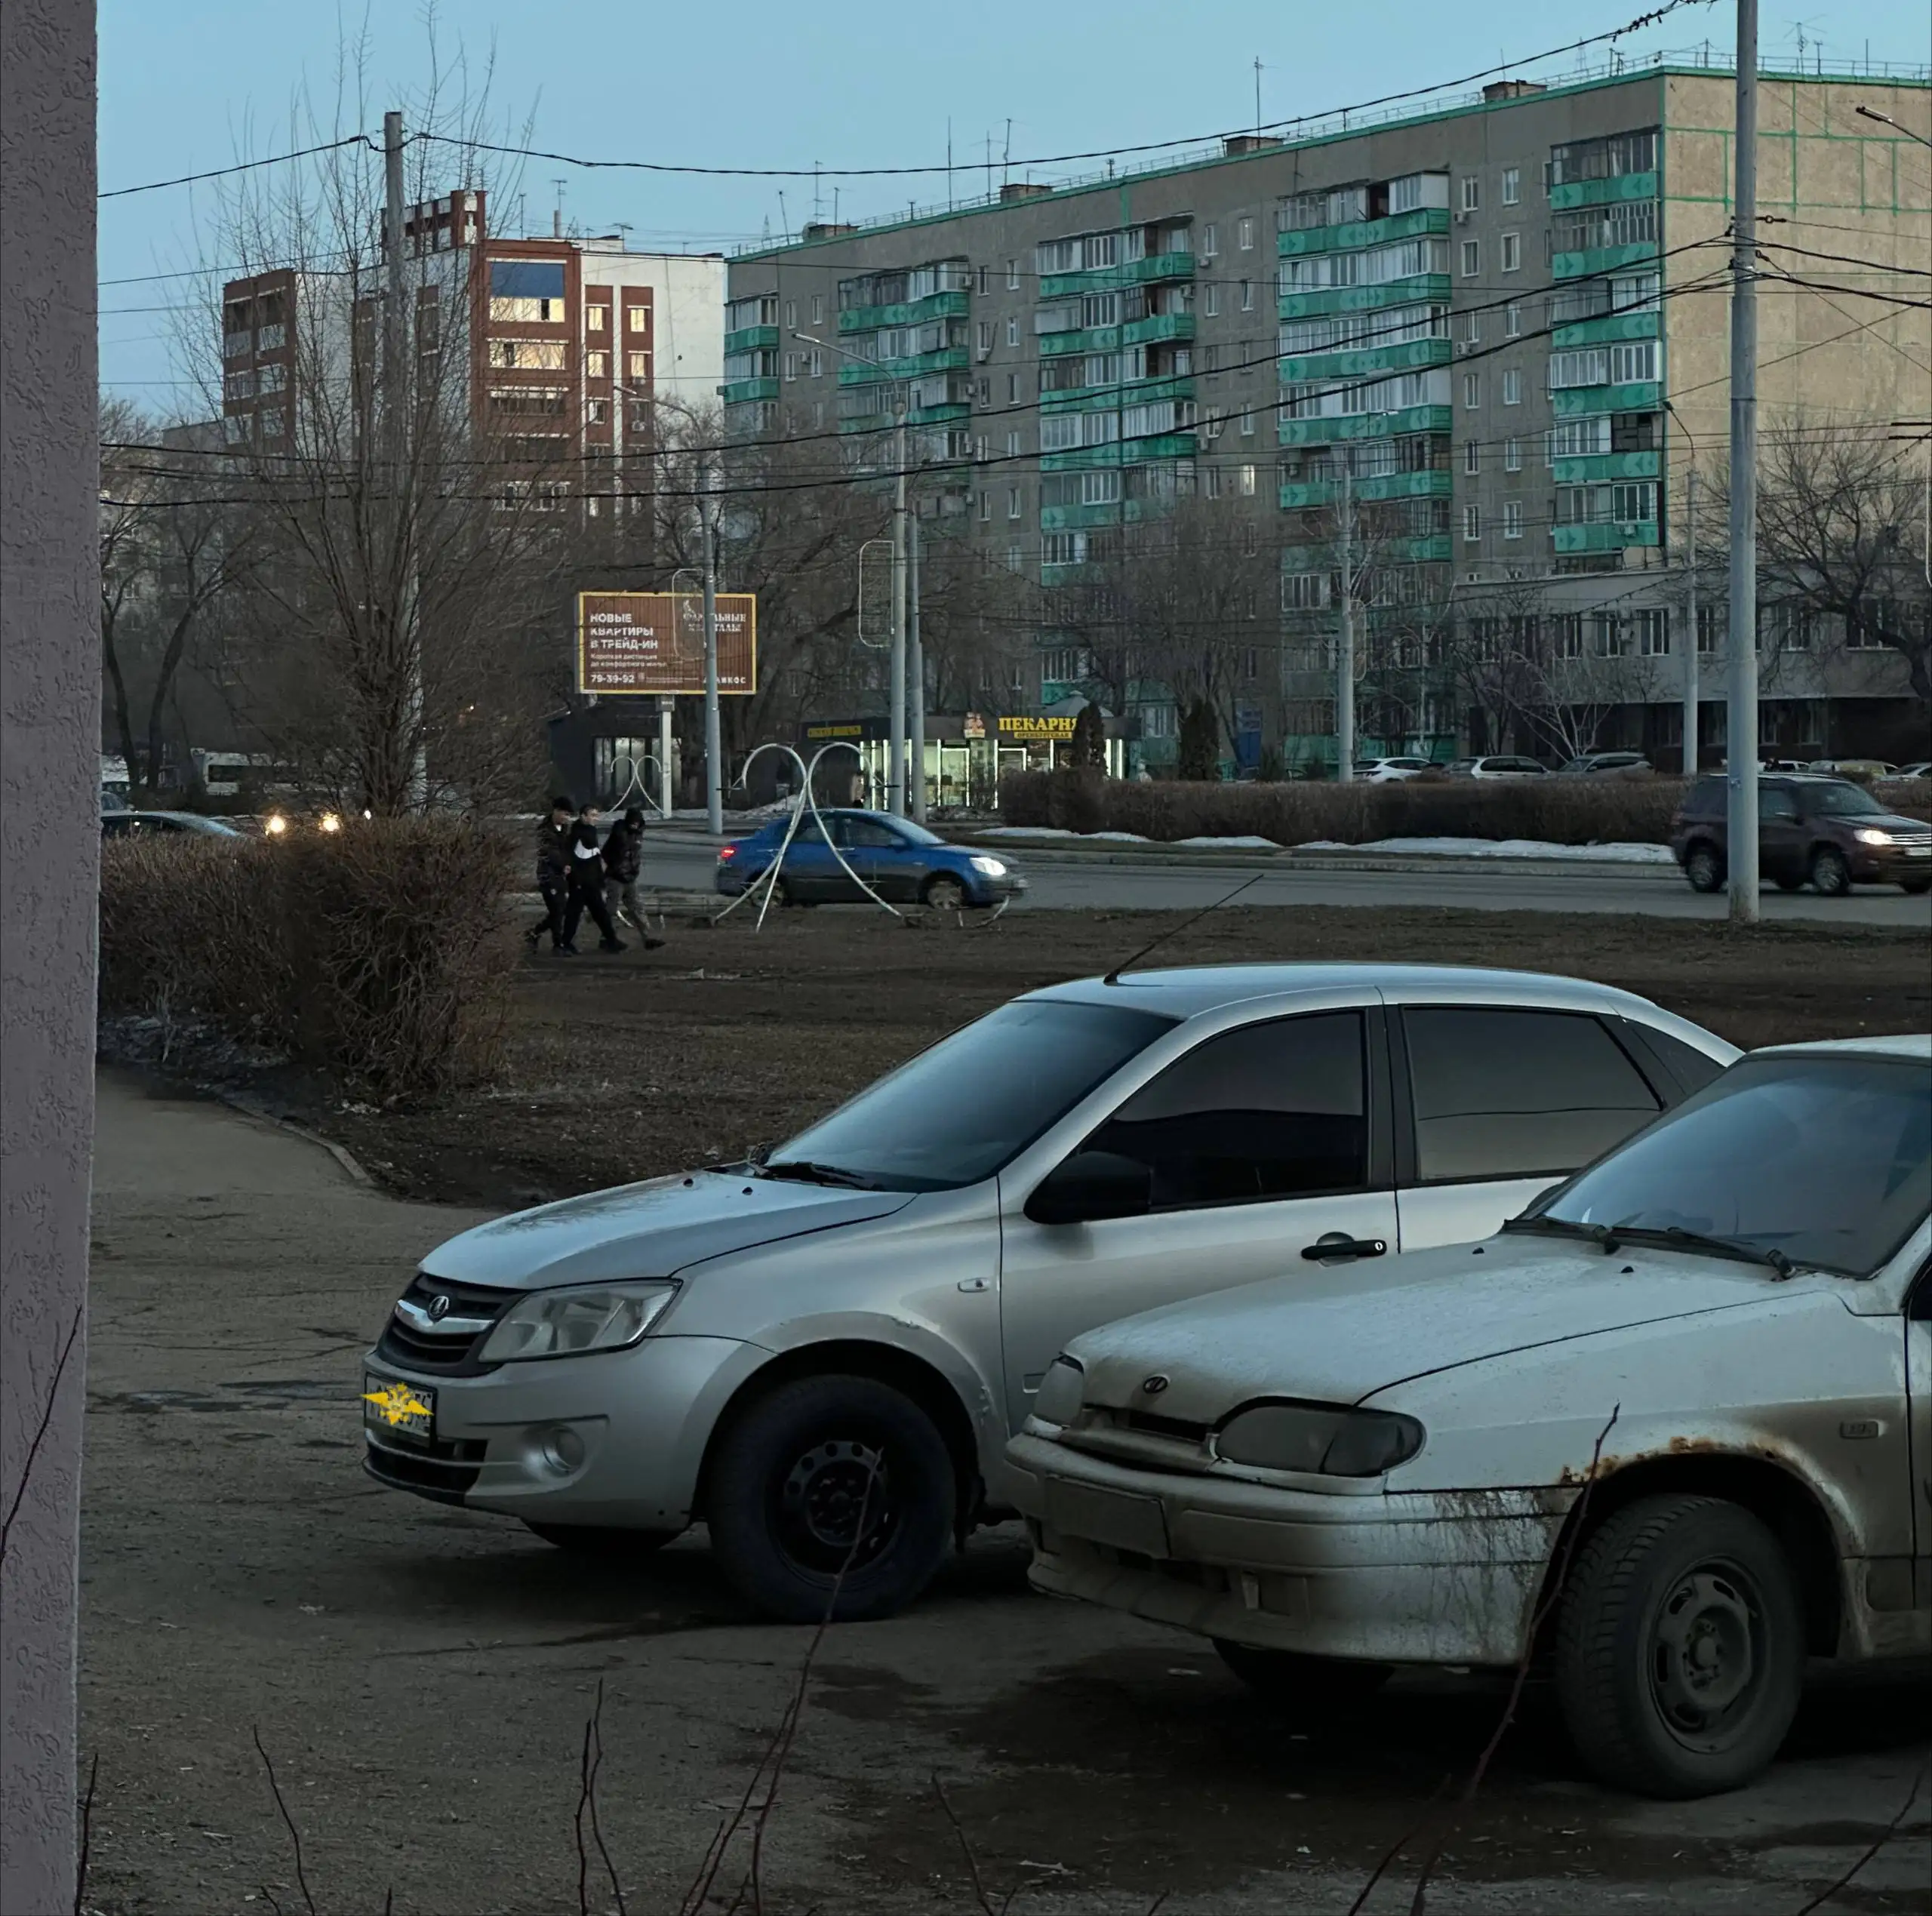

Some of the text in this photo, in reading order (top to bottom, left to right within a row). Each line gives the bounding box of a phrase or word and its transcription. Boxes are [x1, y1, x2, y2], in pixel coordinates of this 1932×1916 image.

[590, 614, 632, 623] НОВЫЕ
[590, 627, 654, 637] КВАРТИРЫ
[589, 637, 658, 650] В ТРЕЙД-ИН
